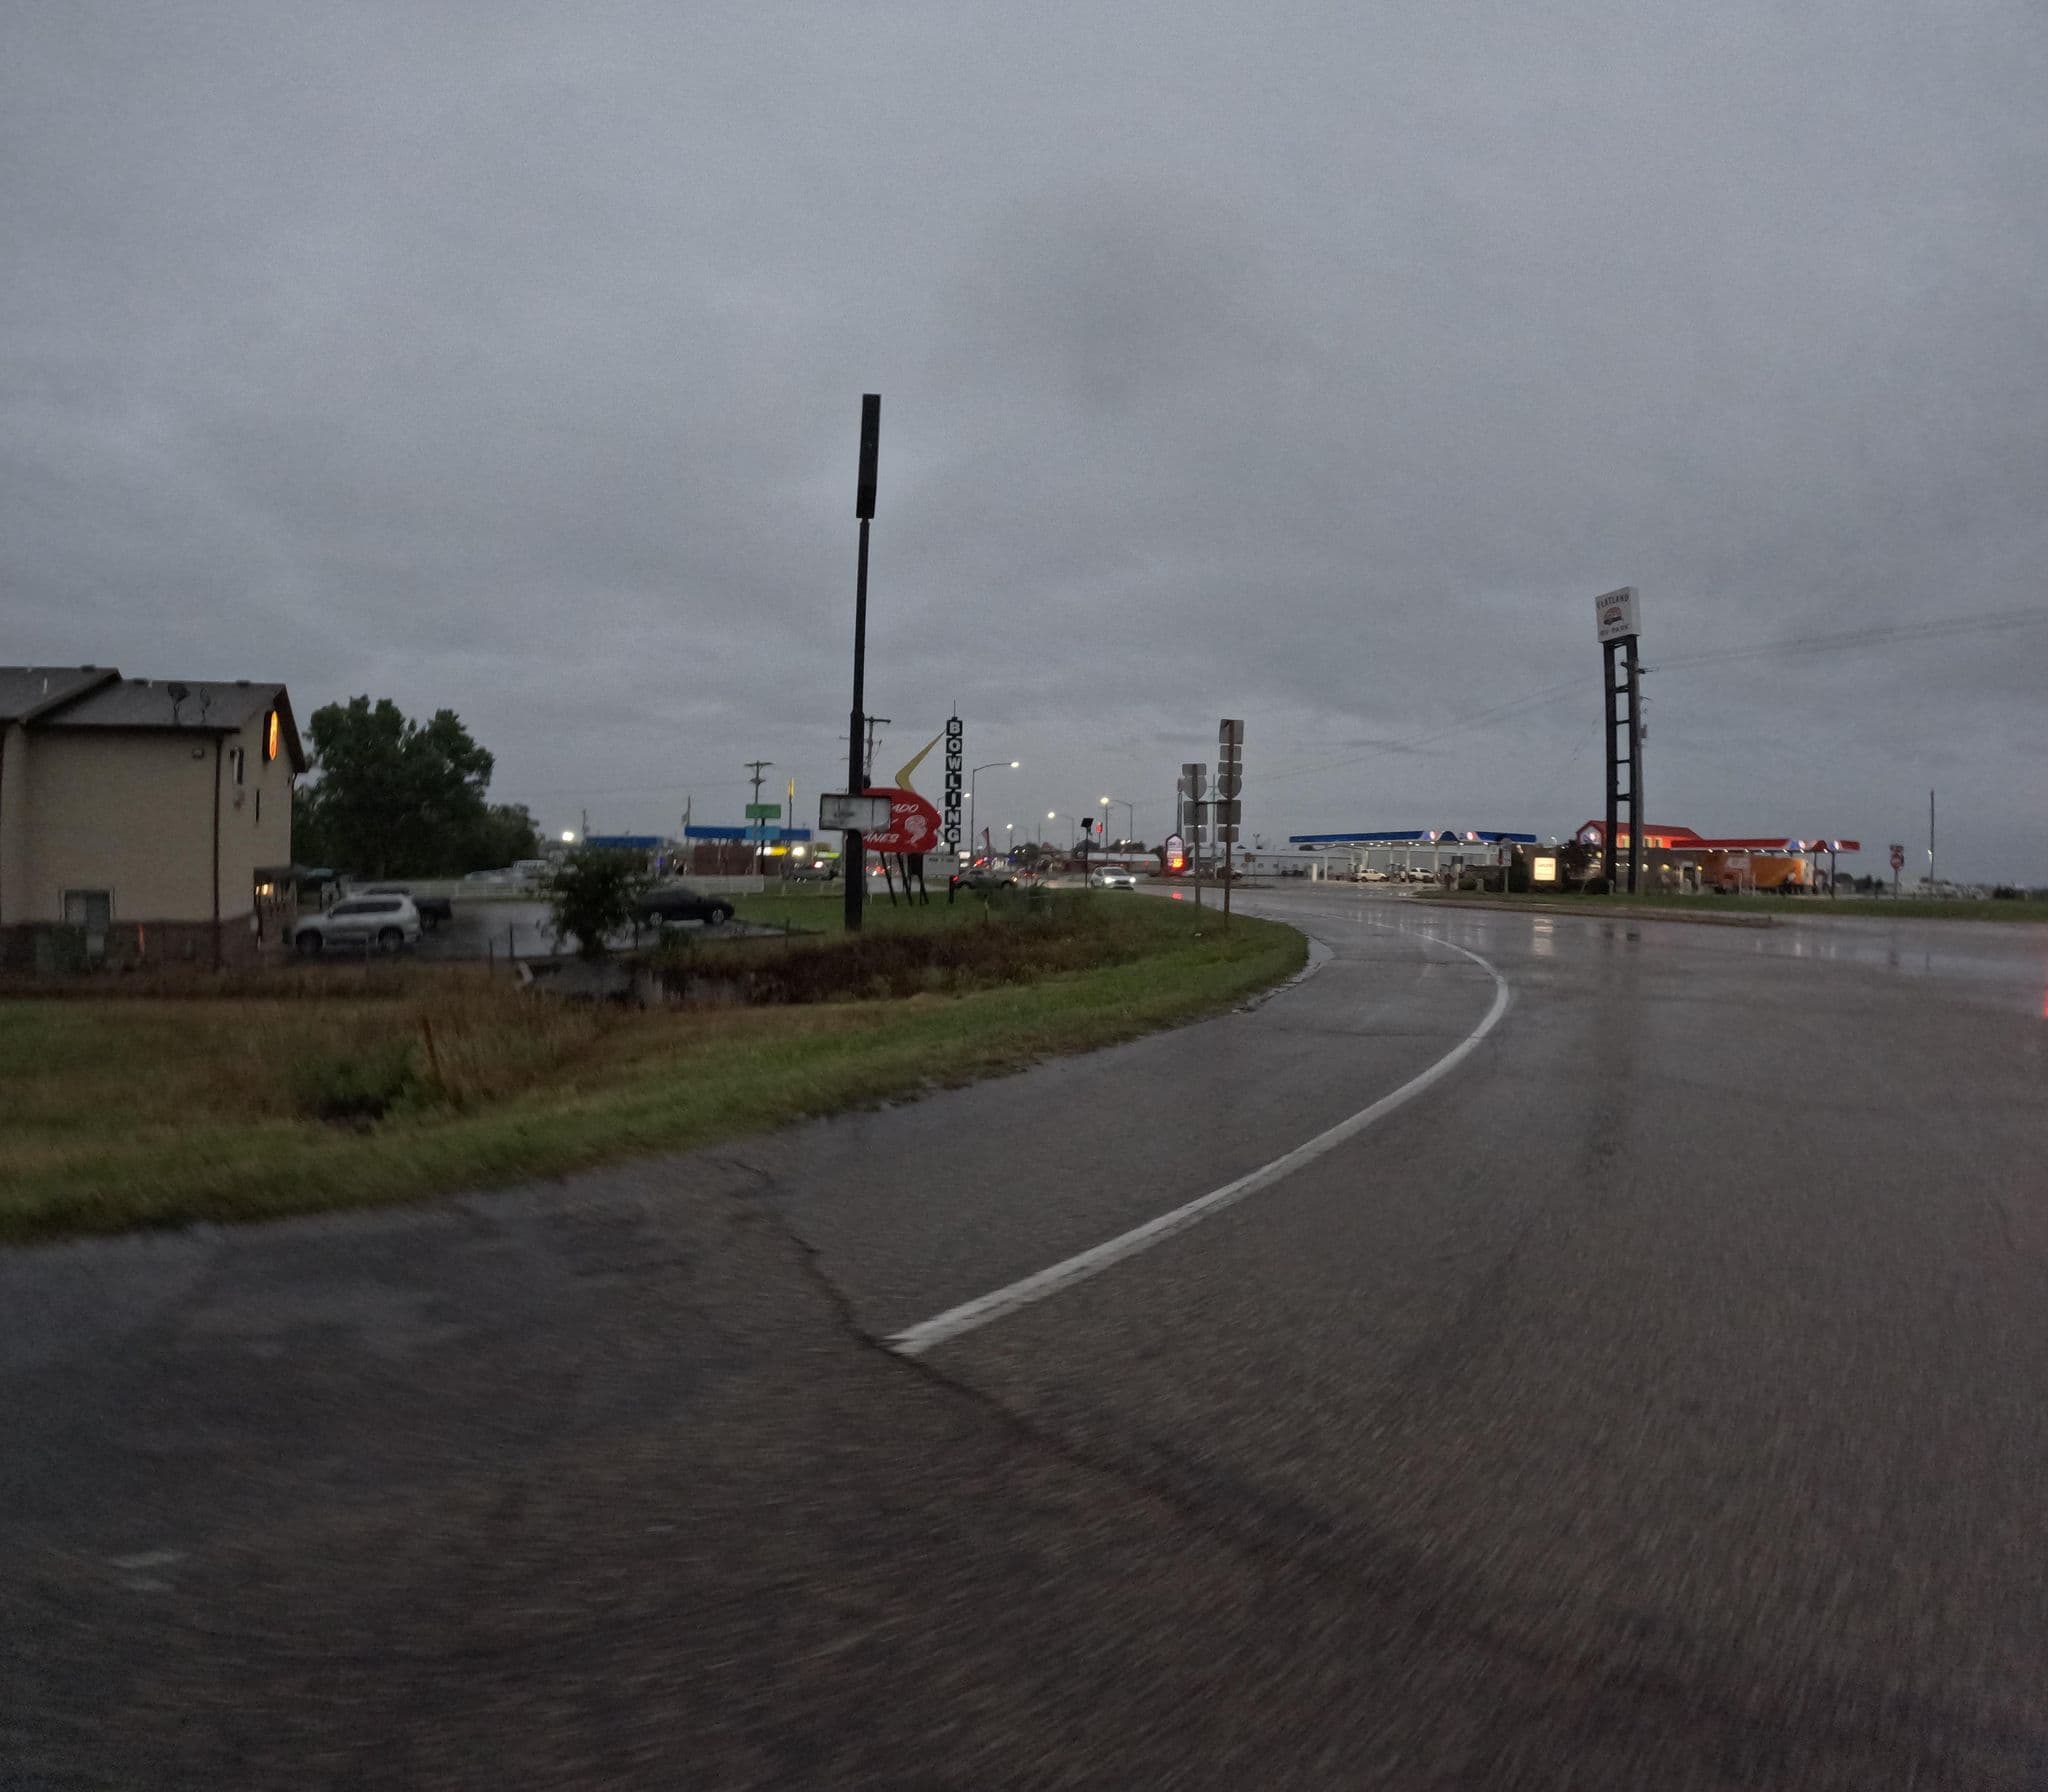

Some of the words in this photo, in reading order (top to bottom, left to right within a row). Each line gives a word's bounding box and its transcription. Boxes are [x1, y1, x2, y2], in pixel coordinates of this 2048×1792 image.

[947, 721, 961, 843] BOWLING
[892, 803, 919, 813] ADO
[863, 832, 900, 844] ANES
